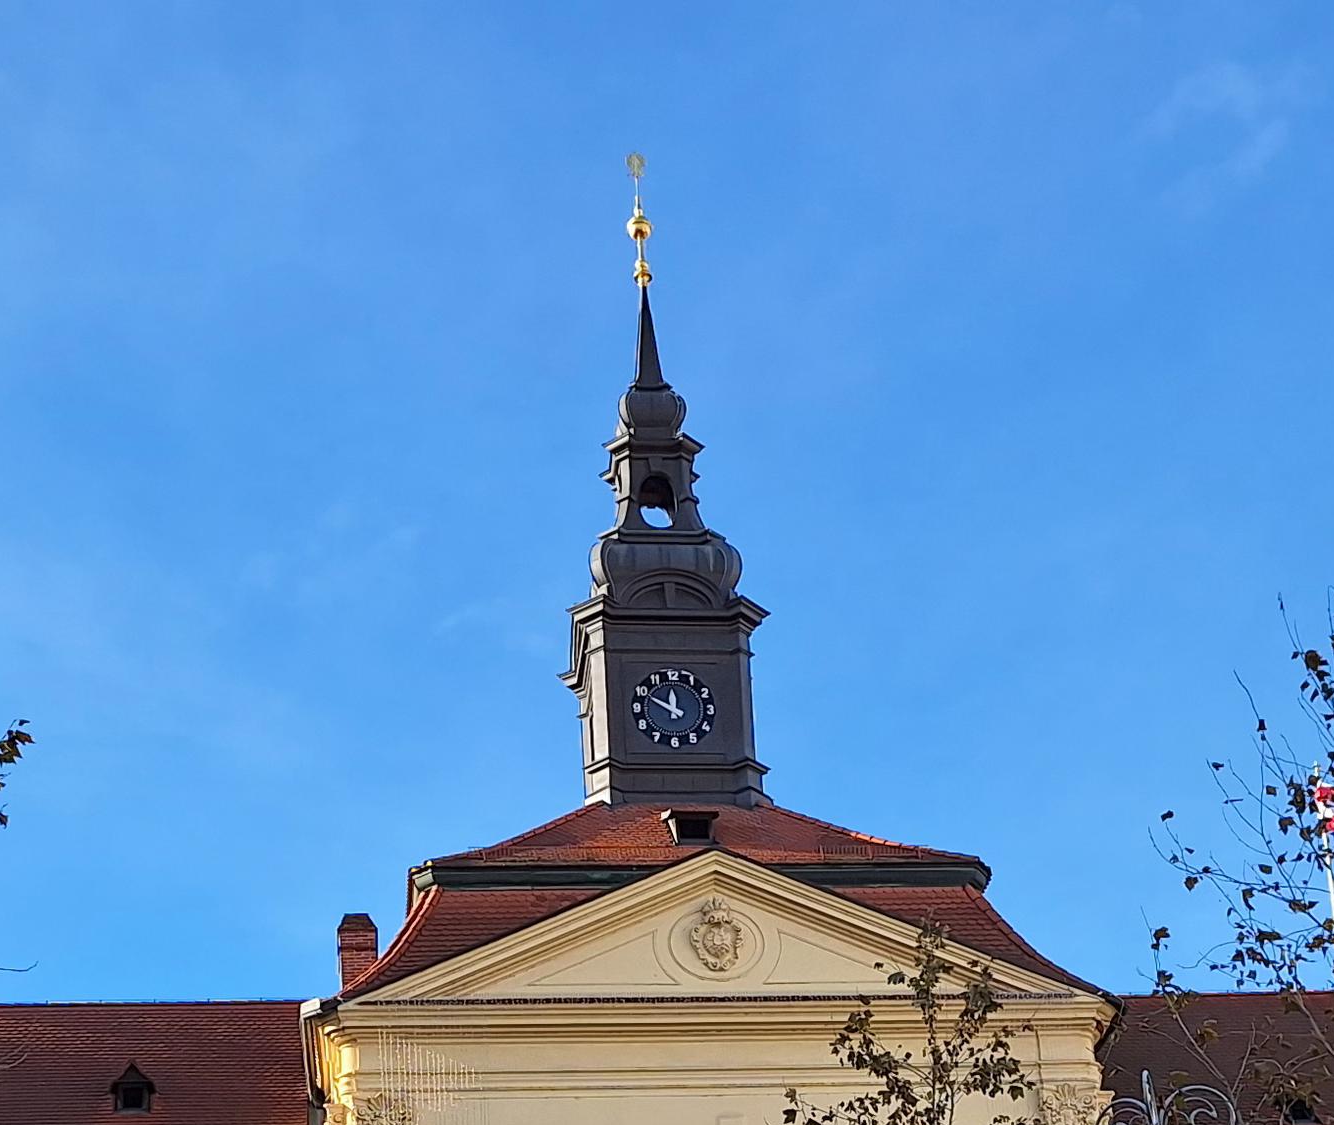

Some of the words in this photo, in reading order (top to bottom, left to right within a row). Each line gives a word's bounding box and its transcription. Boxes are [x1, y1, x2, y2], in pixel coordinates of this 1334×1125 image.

[650, 674, 660, 685] 11
[667, 671, 679, 680] 12
[689, 675, 694, 686] 1
[635, 686, 648, 697] 10
[701, 688, 709, 698] 2
[633, 702, 641, 713] 9
[707, 704, 715, 715] 3
[638, 719, 647, 730] 8
[701, 721, 710, 732] 4
[652, 732, 661, 743] 7
[670, 737, 679, 748] 6
[689, 733, 697, 743] 5
